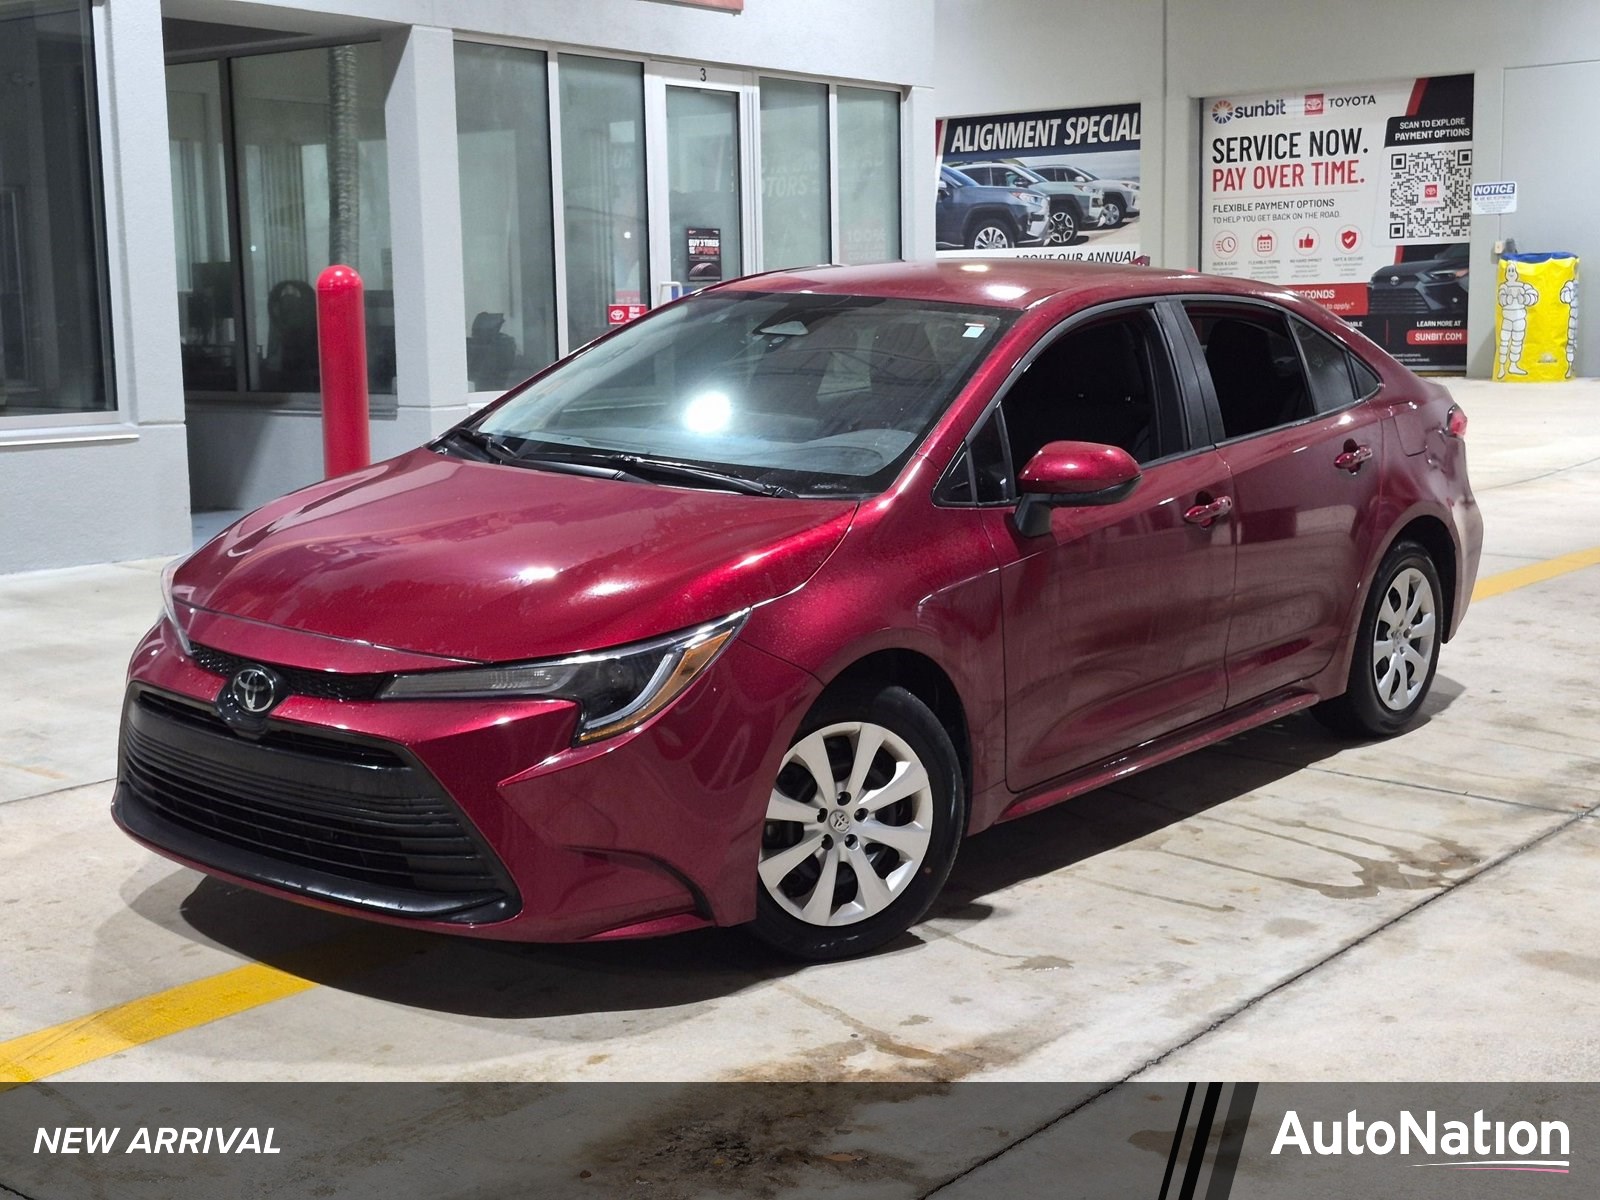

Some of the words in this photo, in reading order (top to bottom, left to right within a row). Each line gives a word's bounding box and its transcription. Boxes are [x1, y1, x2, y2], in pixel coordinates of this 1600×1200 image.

[700, 67, 707, 82] 3
[1328, 95, 1377, 108] TOYOTA
[1234, 99, 1287, 119] sunbit
[1399, 121, 1420, 130] SCAN
[1421, 120, 1431, 129] TO
[1431, 117, 1466, 127] EXPLORE
[951, 118, 1061, 153] ALIGNMENT
[1064, 112, 1141, 146] SPECIAL
[1394, 130, 1433, 141] PAYMENT
[1434, 128, 1471, 139] OPTIONS
[1212, 132, 1301, 164] SERVICE
[1309, 127, 1369, 158] NOW.
[1212, 166, 1247, 192] PAY
[1253, 163, 1304, 190] OVER
[1311, 159, 1365, 186] TIME.
[1474, 184, 1514, 195] NOTICE
[1212, 202, 1253, 214] FLEXIBLE
[1254, 200, 1295, 212] PAYMENT
[1296, 199, 1335, 209] OPTIONS
[1212, 215, 1222, 224] TO
[1223, 214, 1242, 224] HELP
[1242, 214, 1256, 223] YOU
[1256, 213, 1270, 223] GET
[1270, 212, 1291, 222] BACK
[1292, 212, 1303, 221] ON
[1304, 211, 1318, 220] THE
[1415, 332, 1463, 341] SUNBIT.COM
